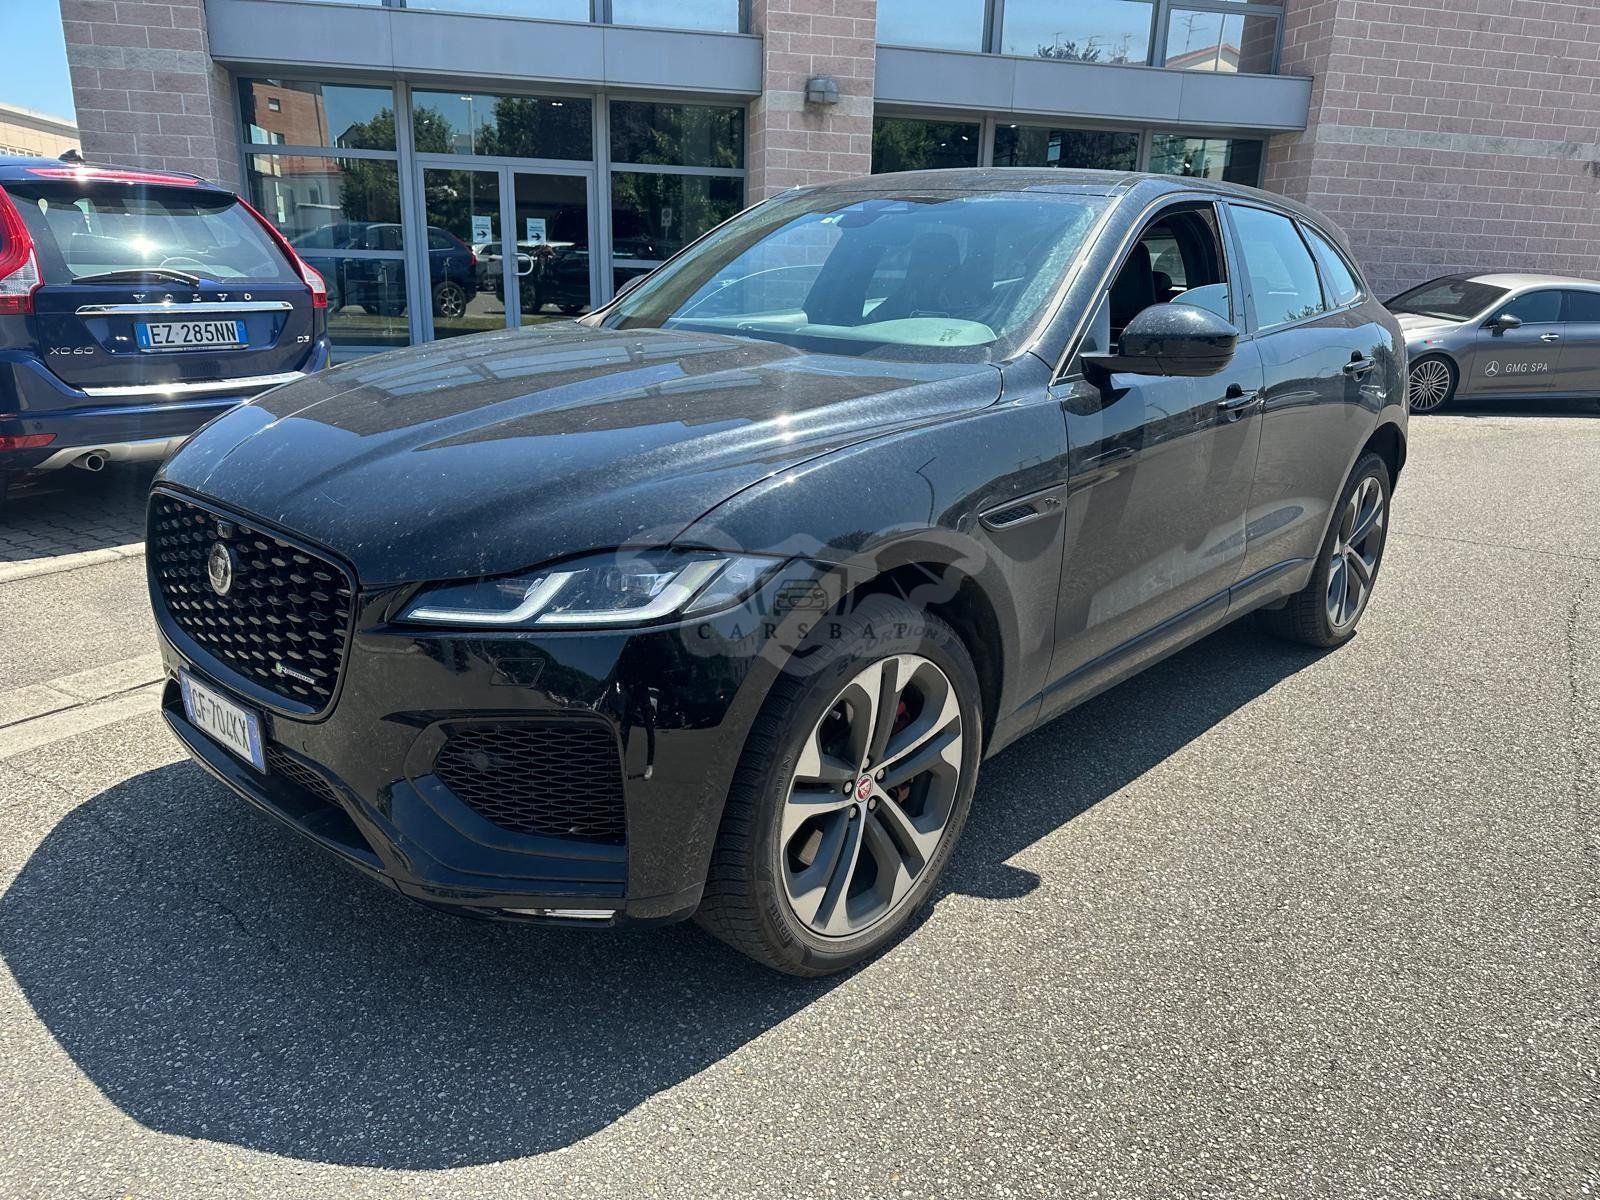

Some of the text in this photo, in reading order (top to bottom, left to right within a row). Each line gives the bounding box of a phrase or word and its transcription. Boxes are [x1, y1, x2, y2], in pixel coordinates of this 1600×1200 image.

[132, 292, 252, 303] VOLVO
[180, 322, 237, 344] 285NN
[296, 335, 310, 343] D3
[1505, 362, 1549, 373] GMG SPA
